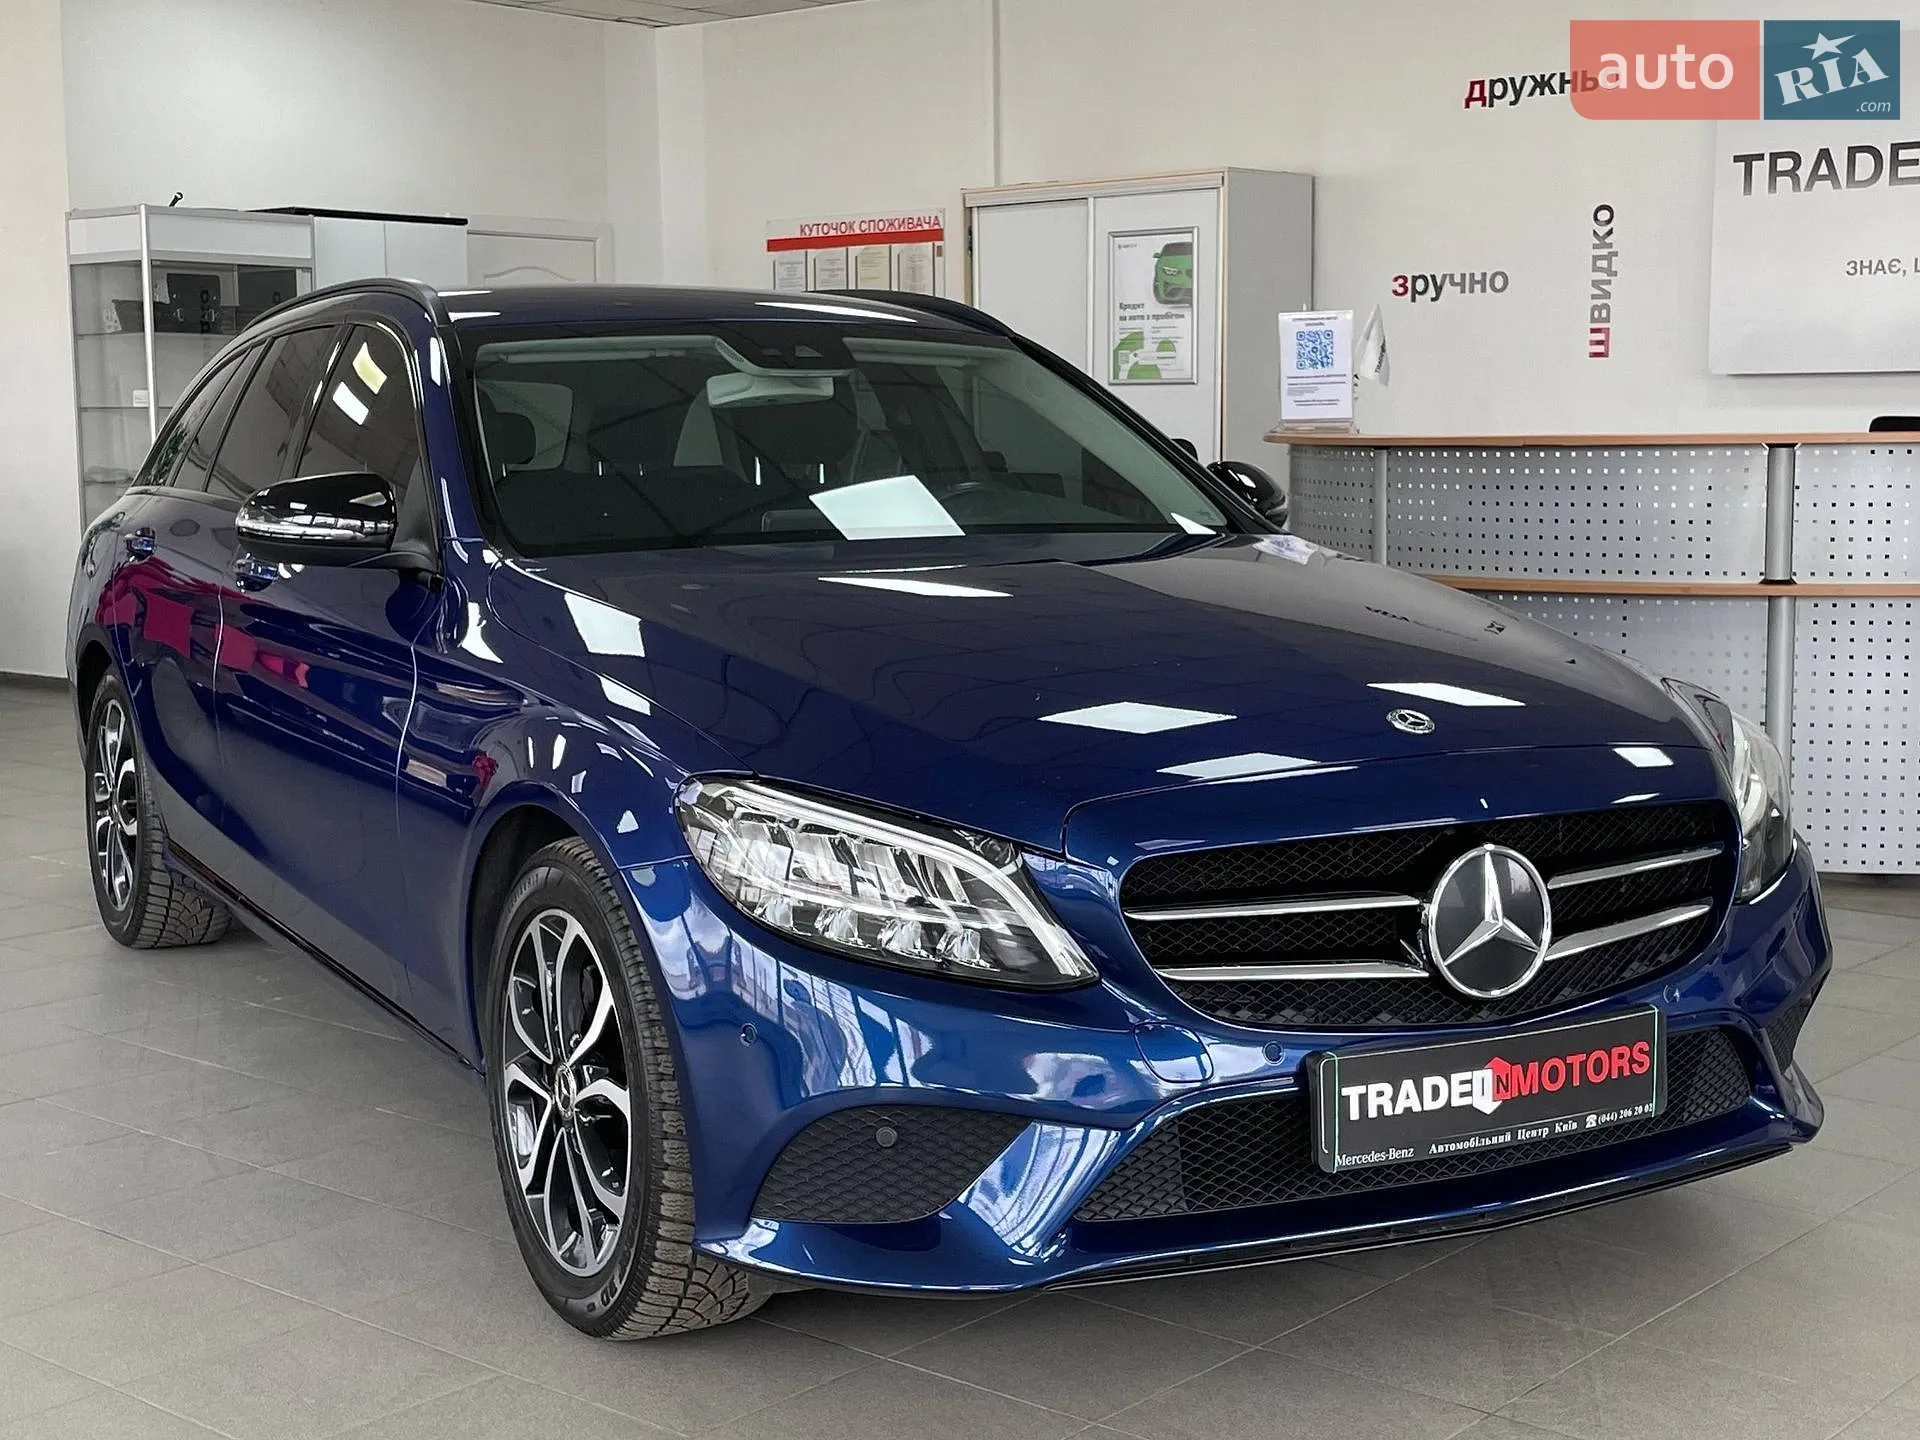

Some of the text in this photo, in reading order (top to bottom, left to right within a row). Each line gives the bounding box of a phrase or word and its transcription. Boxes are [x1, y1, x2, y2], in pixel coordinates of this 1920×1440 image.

[1464, 69, 1620, 109] дружнь
[1732, 141, 1920, 196] TRADE
[800, 216, 942, 236] КУТОЧОК СПОЖИВАЧА
[1846, 257, 1907, 277] ЗНАЄ,
[1391, 270, 1510, 303] зручно
[1428, 1131, 1512, 1155] Автомобільний
[1517, 1124, 1550, 1141] Центр
[1554, 1120, 1578, 1134] Київ
[1597, 1110, 1618, 1125] (044)
[1335, 1147, 1415, 1167] Mercedes-Benz
